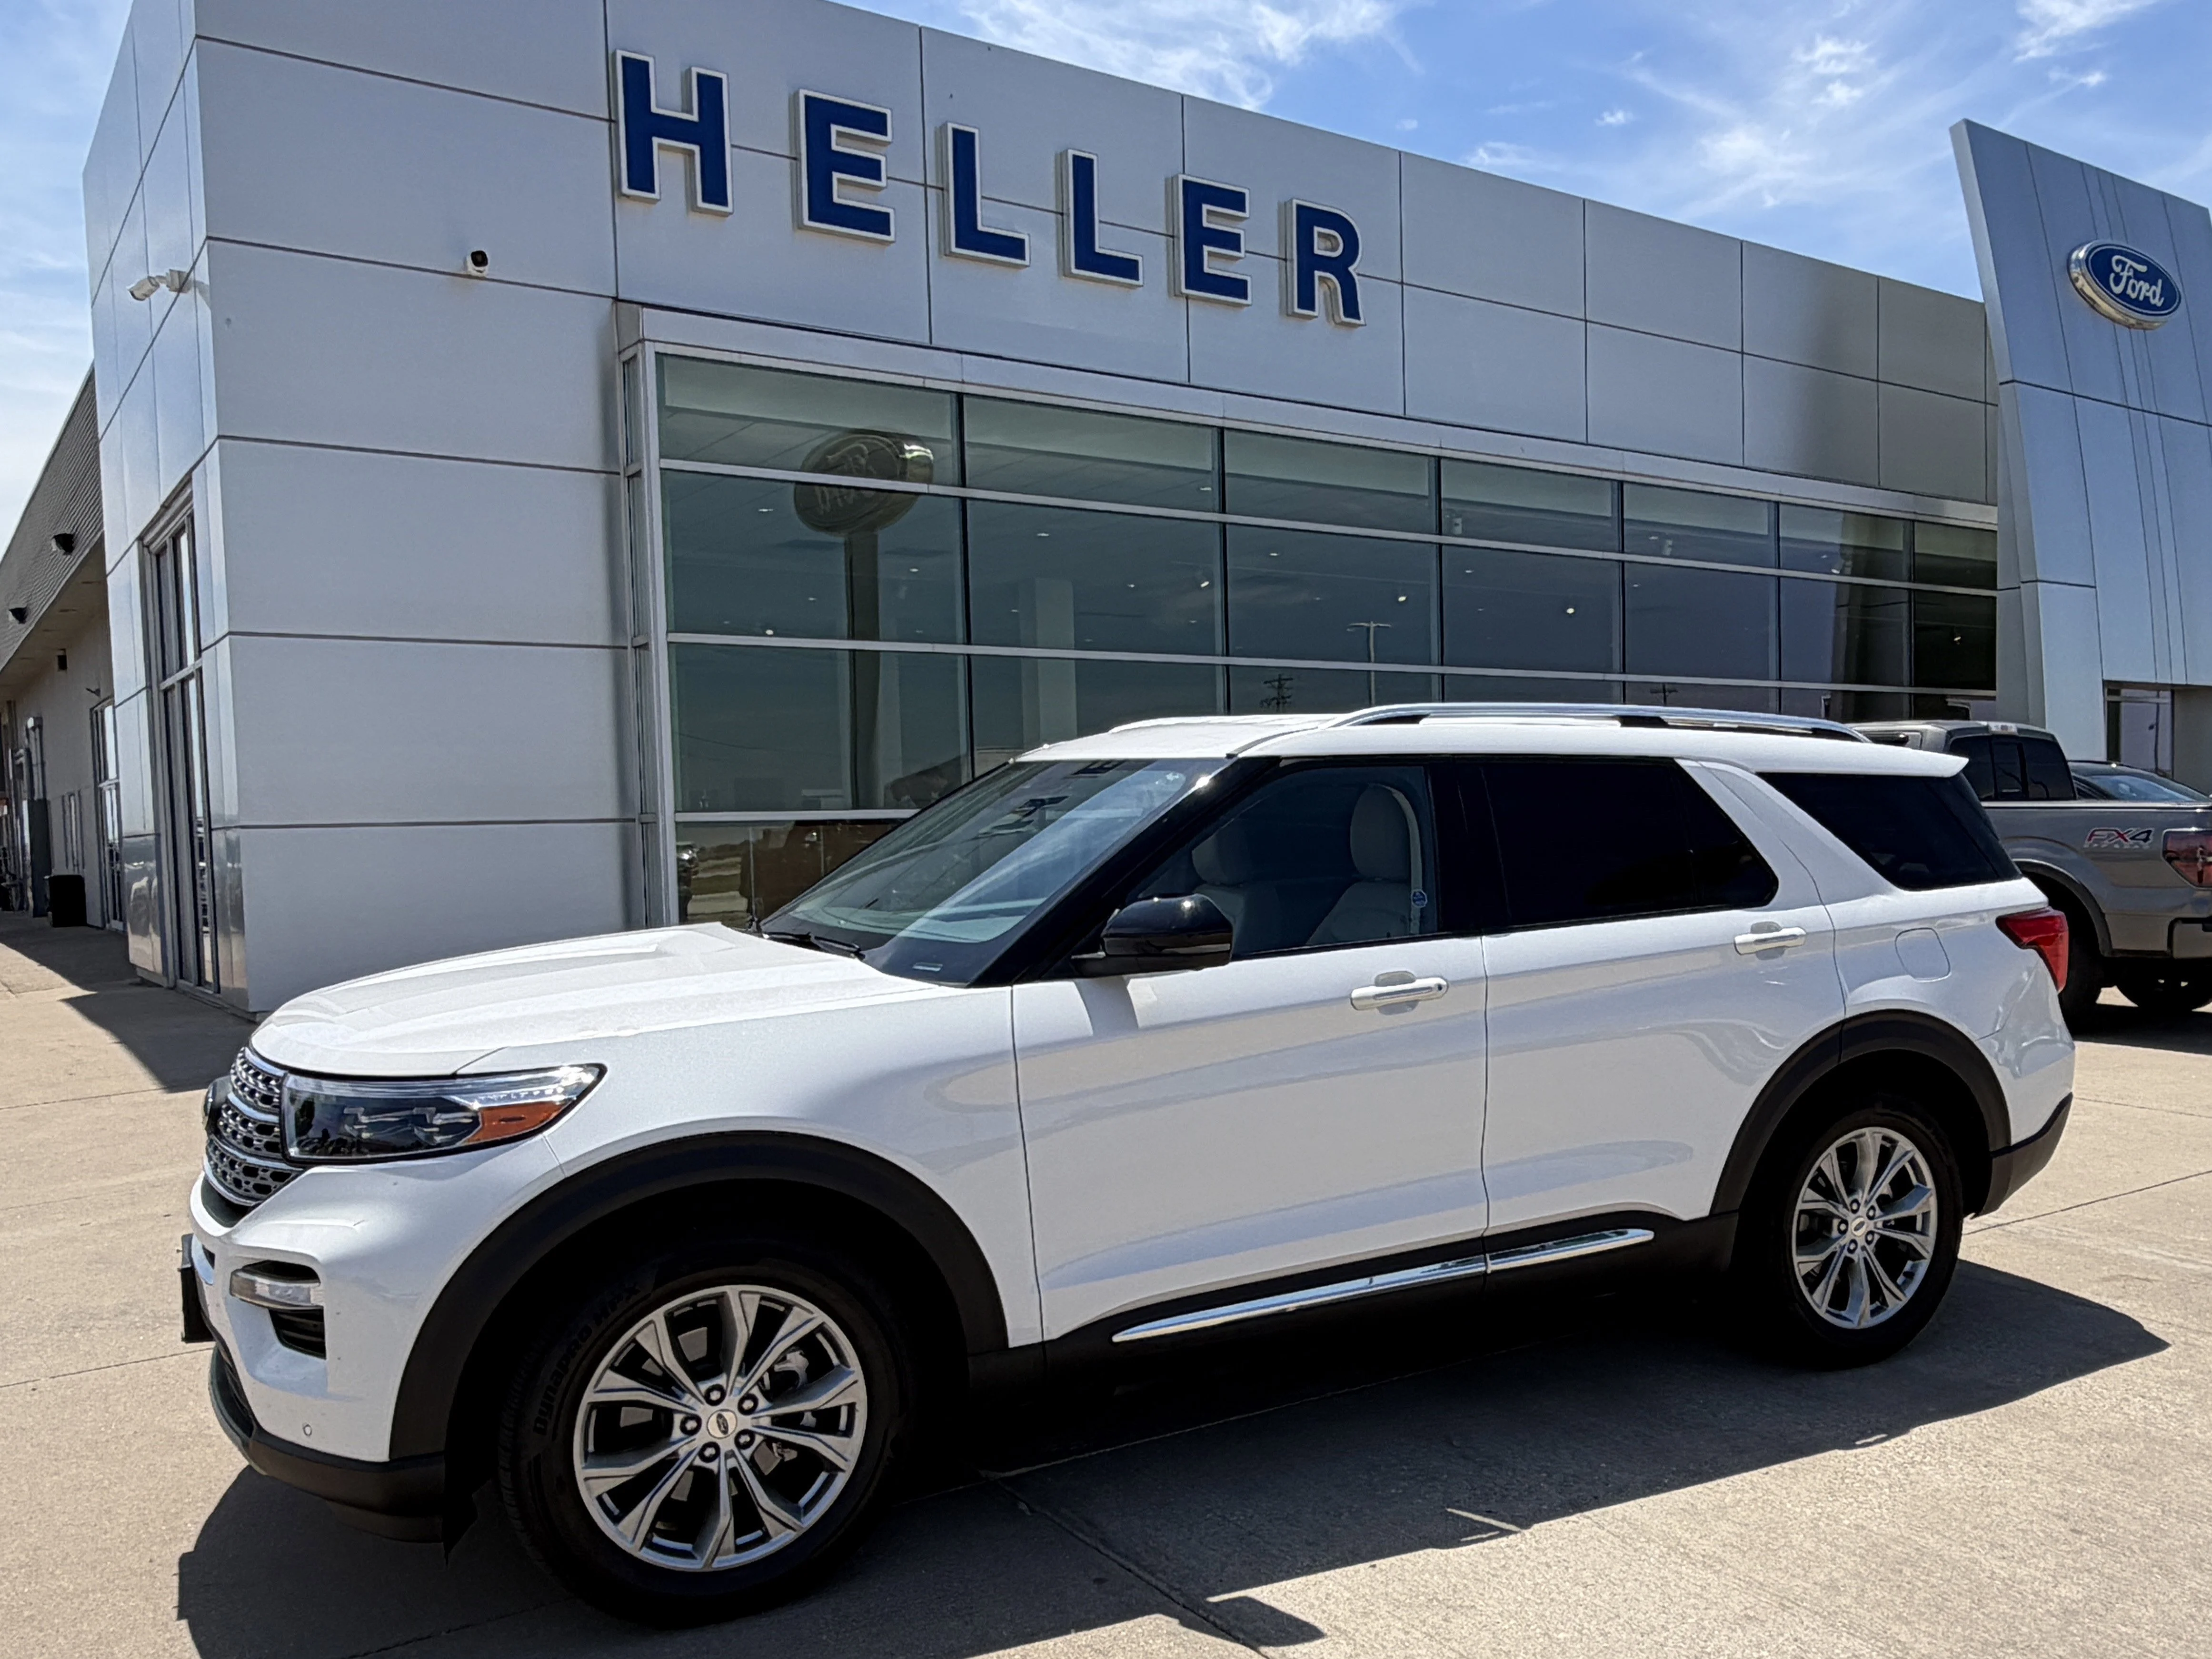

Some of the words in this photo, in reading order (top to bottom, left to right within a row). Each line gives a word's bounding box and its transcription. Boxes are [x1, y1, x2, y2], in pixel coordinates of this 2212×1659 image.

[616, 49, 1366, 326] HELLER
[2110, 255, 2164, 307] Ford
[2085, 827, 2154, 843] FX4
